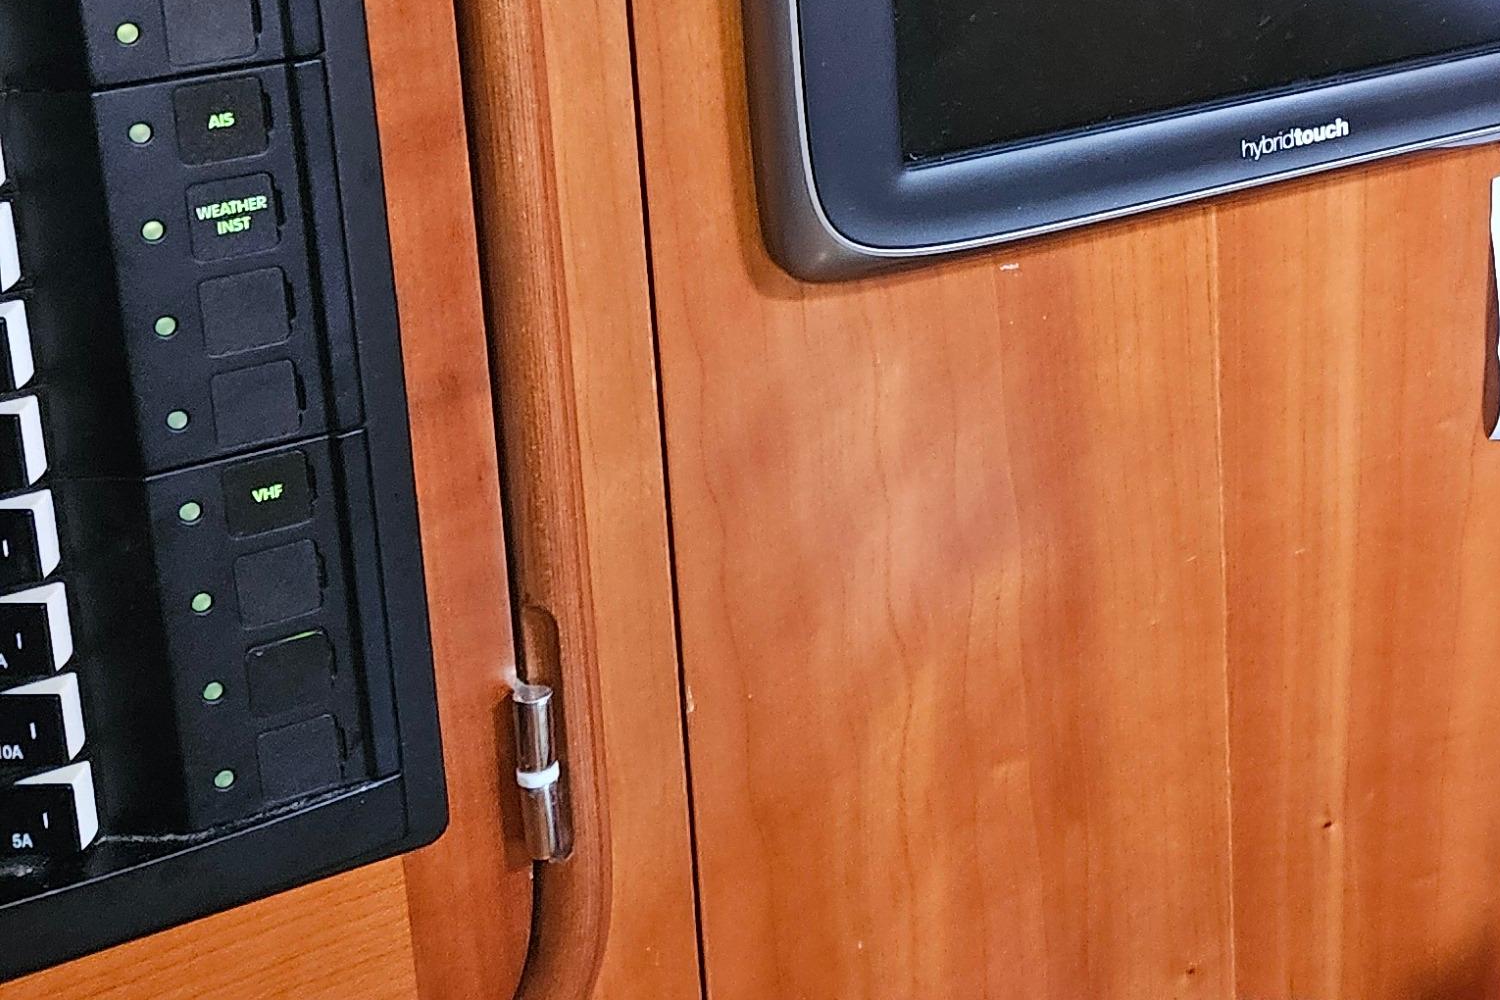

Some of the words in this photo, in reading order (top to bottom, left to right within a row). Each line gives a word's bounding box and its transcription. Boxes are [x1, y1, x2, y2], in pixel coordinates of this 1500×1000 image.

[208, 111, 235, 130] AIS
[1241, 118, 1349, 160] hybridtouch
[196, 195, 268, 221] WEATHER
[217, 215, 251, 236] INST
[251, 483, 284, 503] VHF
[0, 744, 24, 760] 0A
[12, 833, 33, 849] 5A
